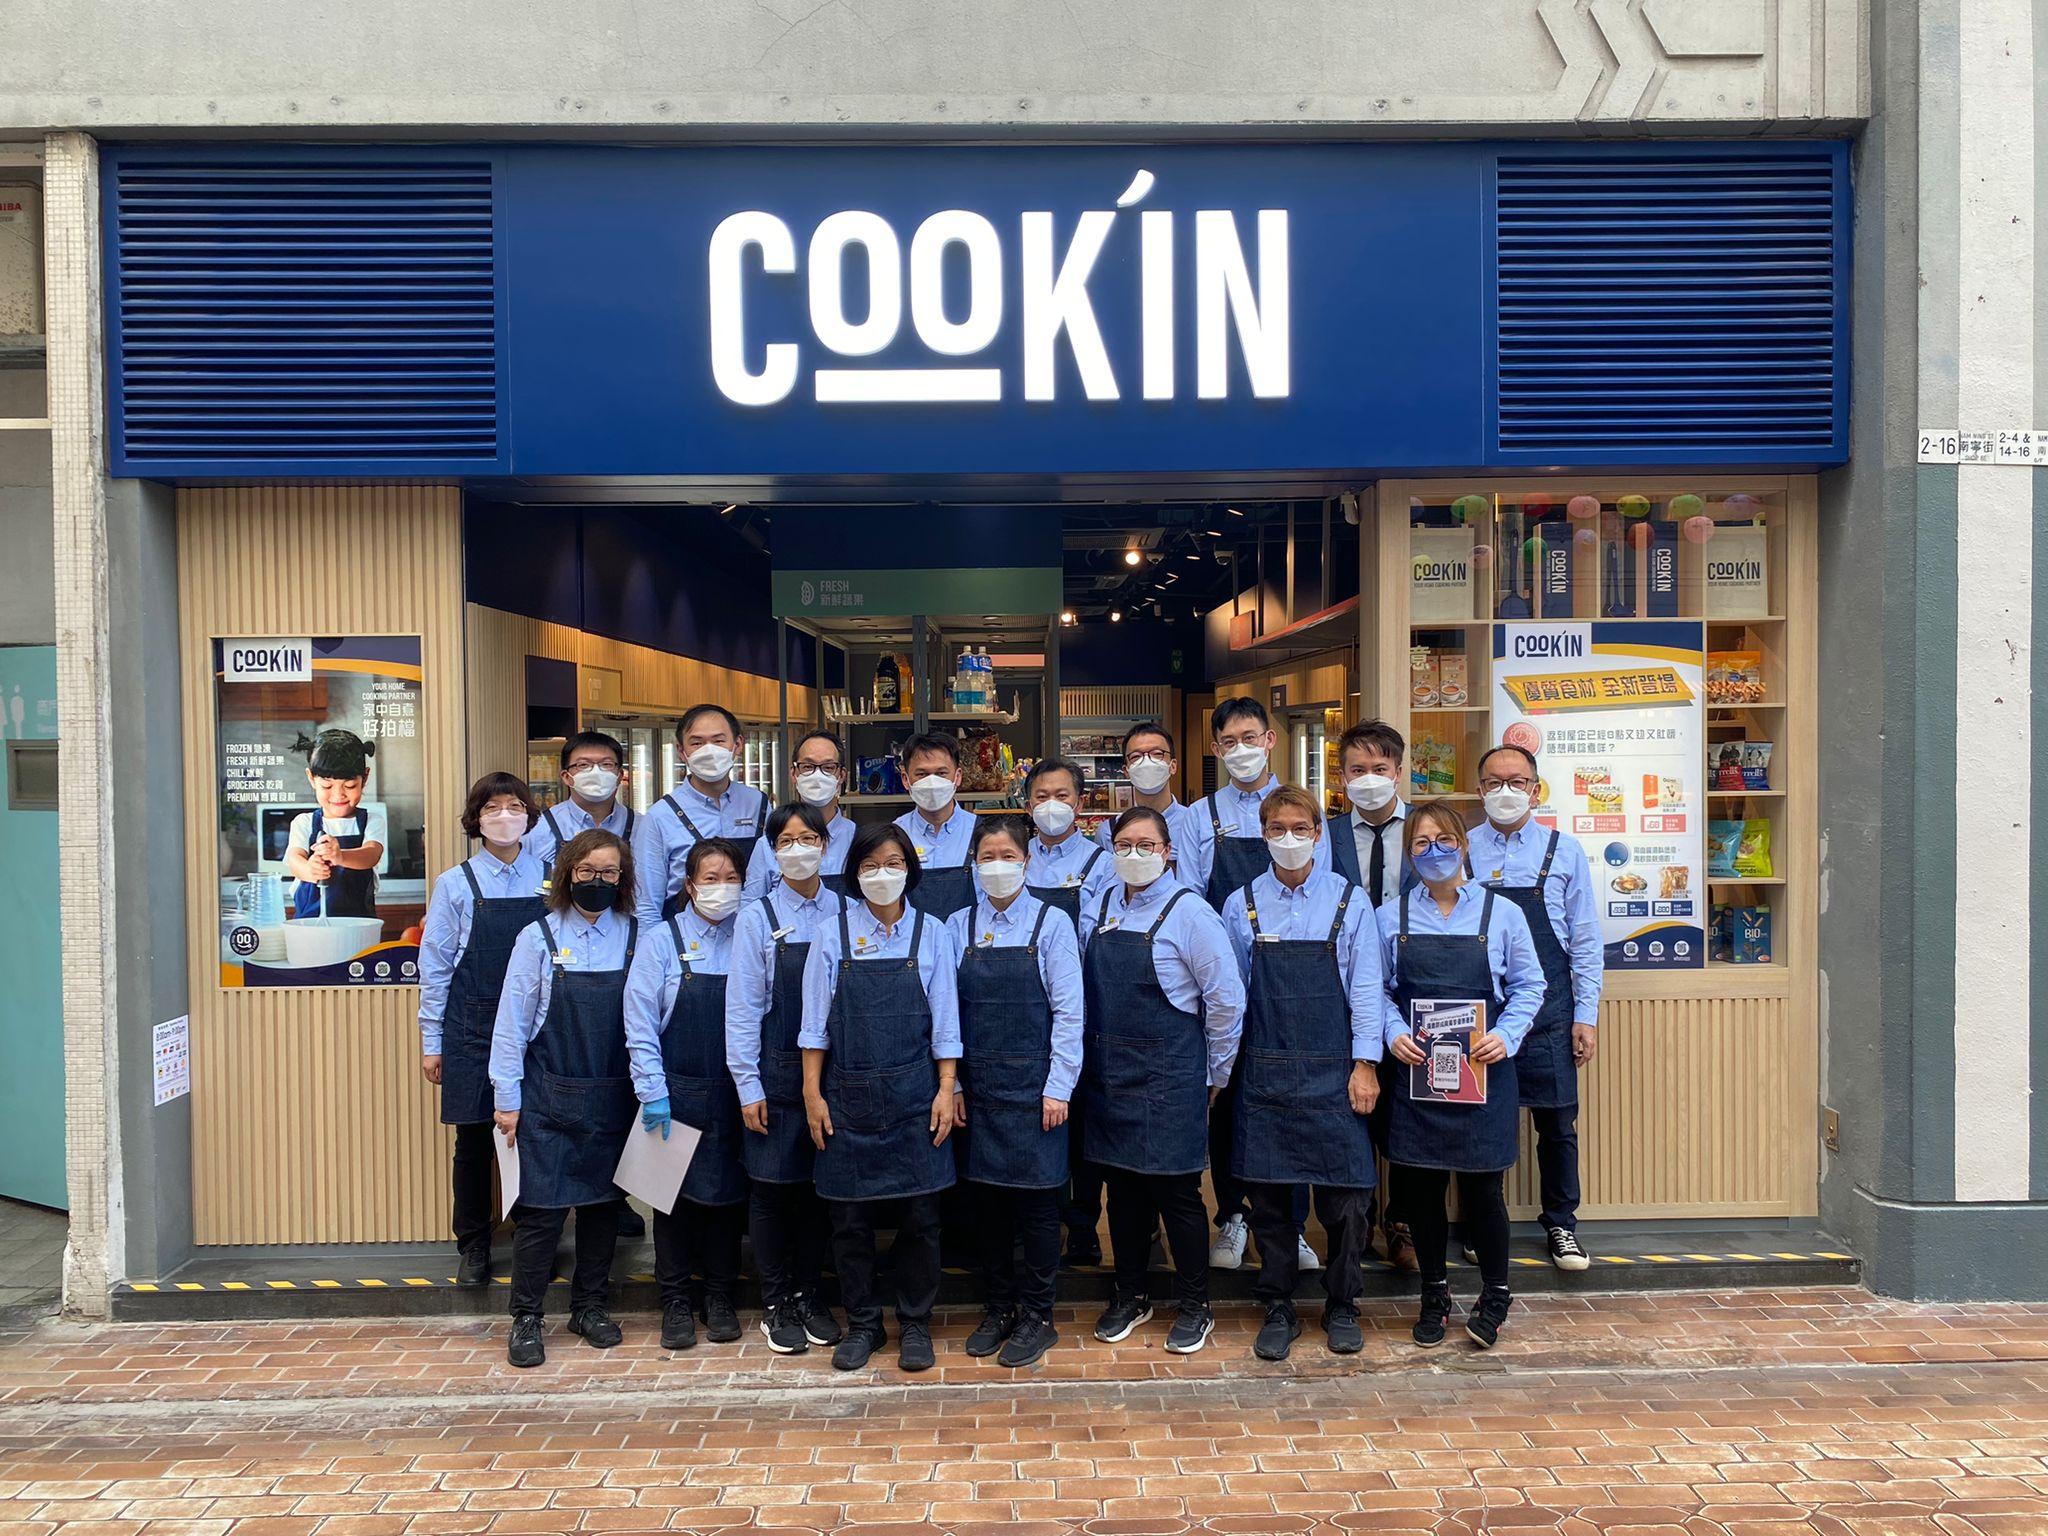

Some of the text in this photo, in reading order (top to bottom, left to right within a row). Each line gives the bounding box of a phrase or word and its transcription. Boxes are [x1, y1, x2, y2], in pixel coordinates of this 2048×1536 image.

[1999, 432, 2031, 444] 2-4 &
[1920, 437, 1956, 455] 2-16
[1999, 446, 2030, 457] 14-16
[820, 580, 849, 592] FRESH
[1515, 630, 1583, 658] COOKÍN
[233, 645, 302, 672] COOKÍN
[371, 682, 406, 690] YOUR HOME
[1522, 673, 1678, 701] 優質食材 全新登場
[362, 692, 416, 701] COOKING PARTNER
[363, 703, 415, 717] 家中自煮
[363, 719, 415, 738] 好拍檔
[226, 744, 252, 753] FROZEN
[226, 756, 248, 766] FRESH
[226, 769, 245, 777] CHILL
[226, 781, 265, 790] GROCERIES
[227, 793, 260, 802] PREMIUM
[1744, 929, 1761, 939] BIO
